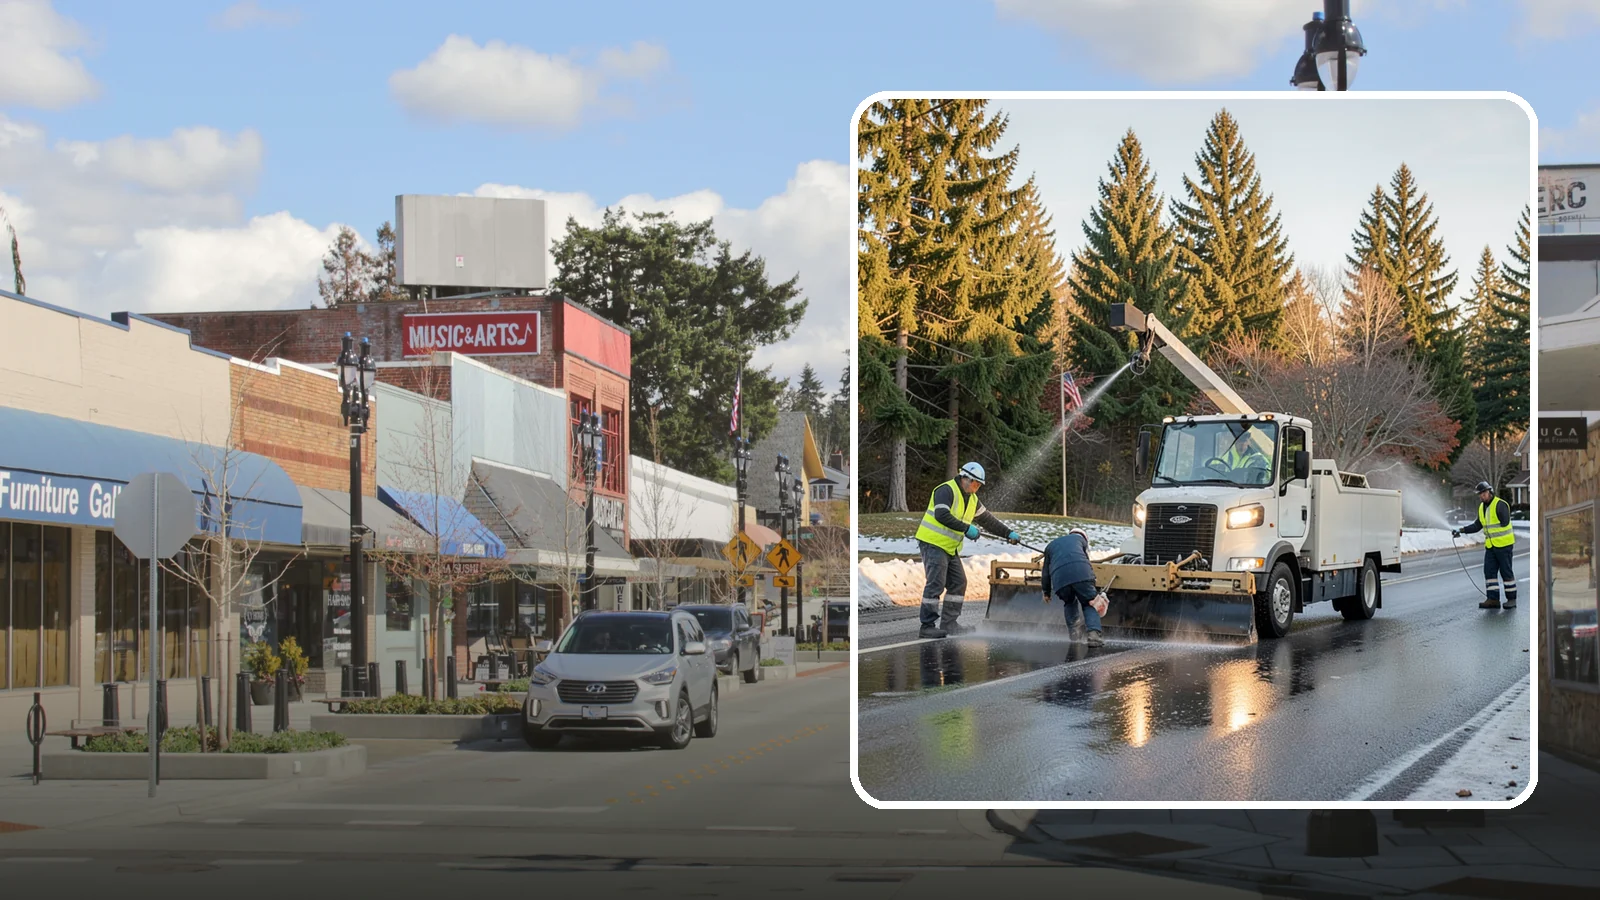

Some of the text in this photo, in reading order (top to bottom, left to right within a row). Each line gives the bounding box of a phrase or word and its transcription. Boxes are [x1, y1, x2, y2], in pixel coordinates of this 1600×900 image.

[408, 322, 520, 349] MUSIC&ARTS
[1540, 427, 1577, 436] UGA
[0, 471, 79, 516] Furniture
